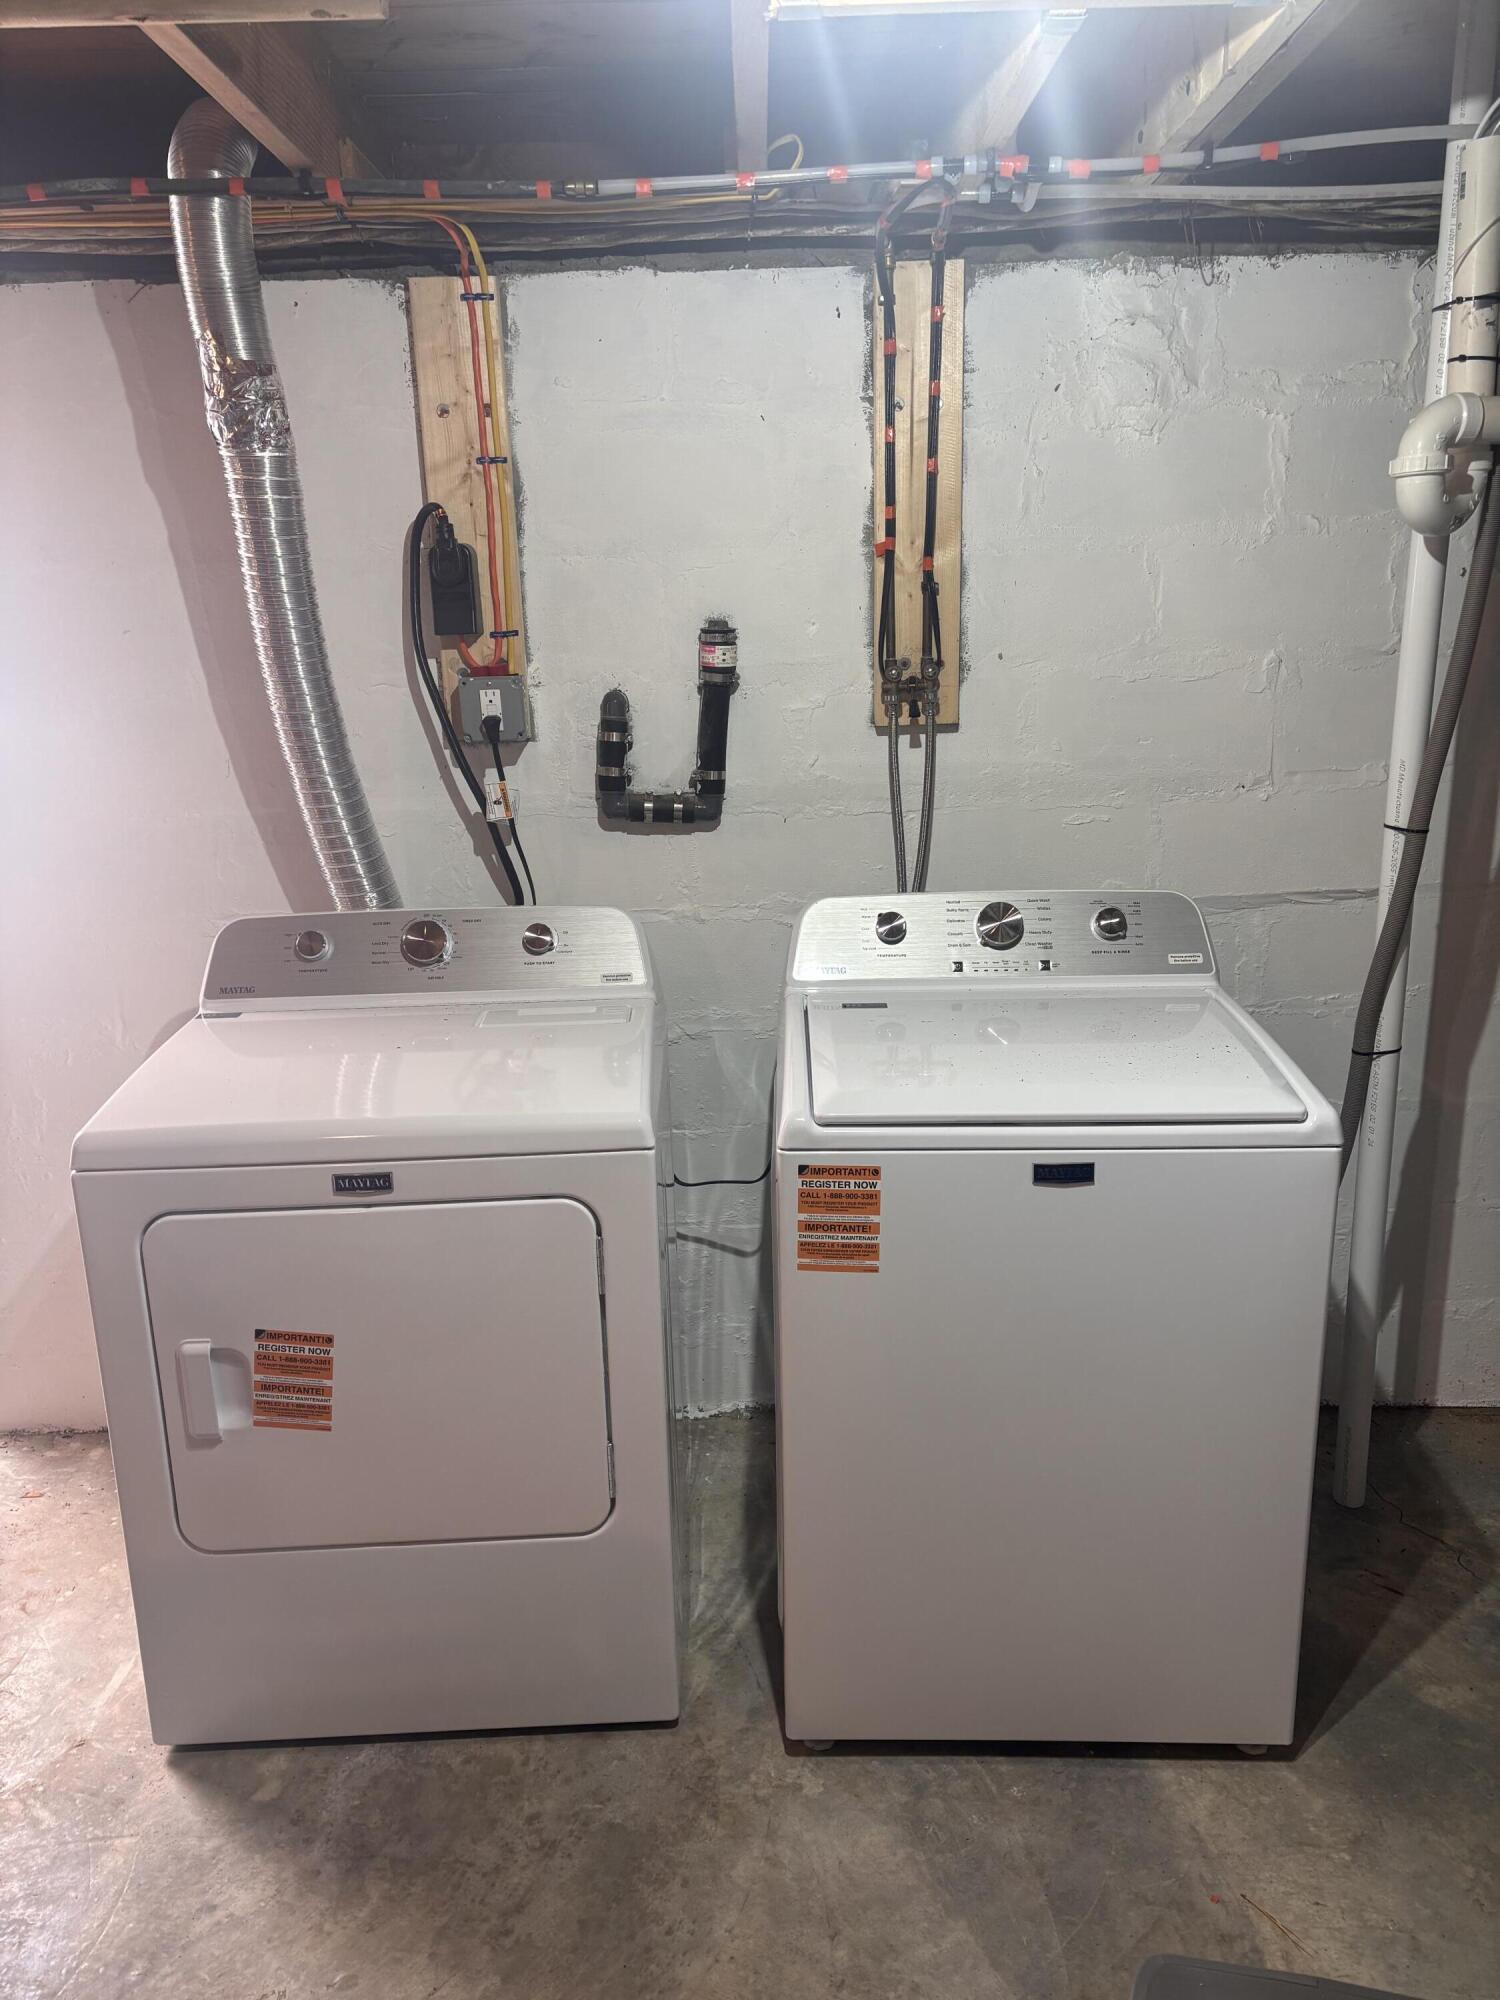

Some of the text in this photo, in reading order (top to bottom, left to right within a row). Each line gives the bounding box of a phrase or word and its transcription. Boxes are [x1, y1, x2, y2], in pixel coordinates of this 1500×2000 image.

[218, 986, 256, 995] MAYTAG
[810, 1167, 871, 1176] IMPORTANT!
[338, 1178, 389, 1188] MAYTAG
[801, 1180, 878, 1189] REGISTER NOW
[804, 1223, 872, 1232] IMPORTANTE!
[266, 1332, 324, 1344] IMPORTANT!
[257, 1344, 331, 1356] REGISTER NOW
[261, 1384, 325, 1395] IMPORTANTE!
